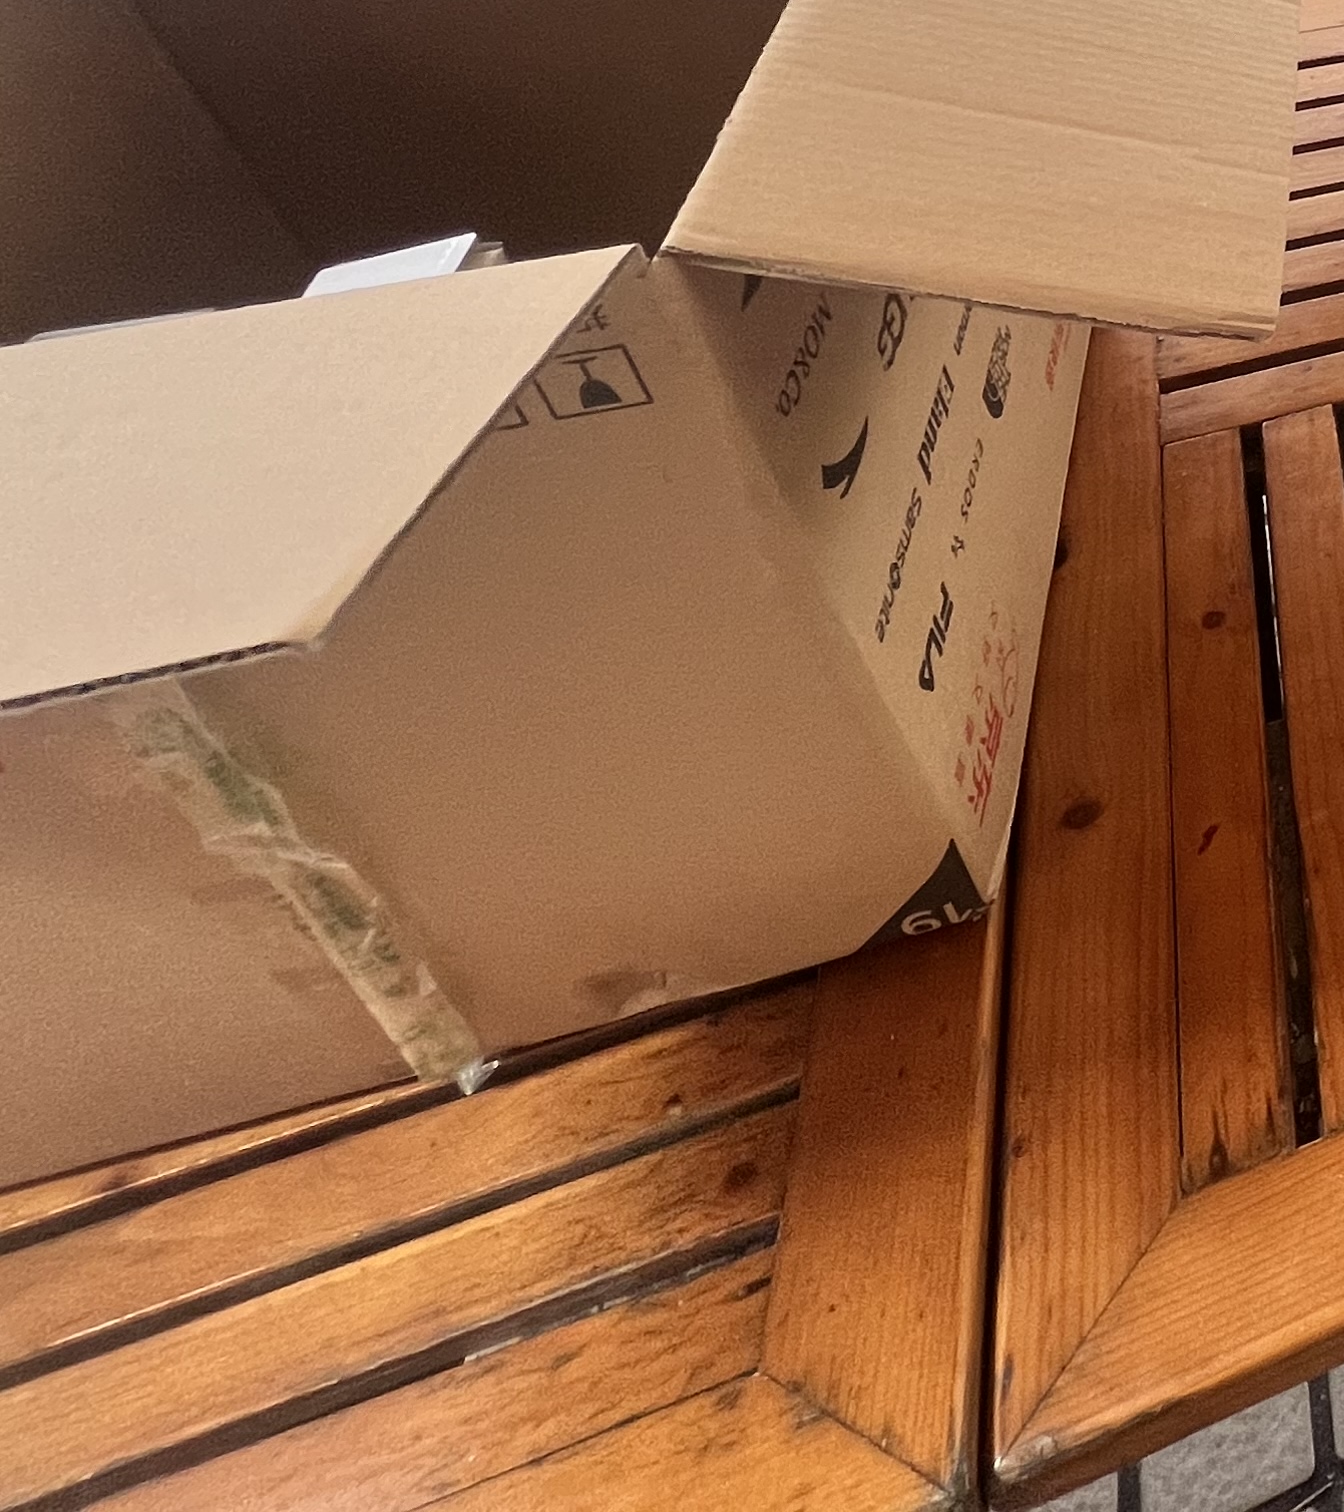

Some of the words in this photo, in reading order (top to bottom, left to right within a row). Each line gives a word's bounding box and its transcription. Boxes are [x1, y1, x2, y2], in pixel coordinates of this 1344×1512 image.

[876, 293, 910, 372] GG
[872, 486, 923, 644] Samsonite
[917, 580, 955, 693] FILA
